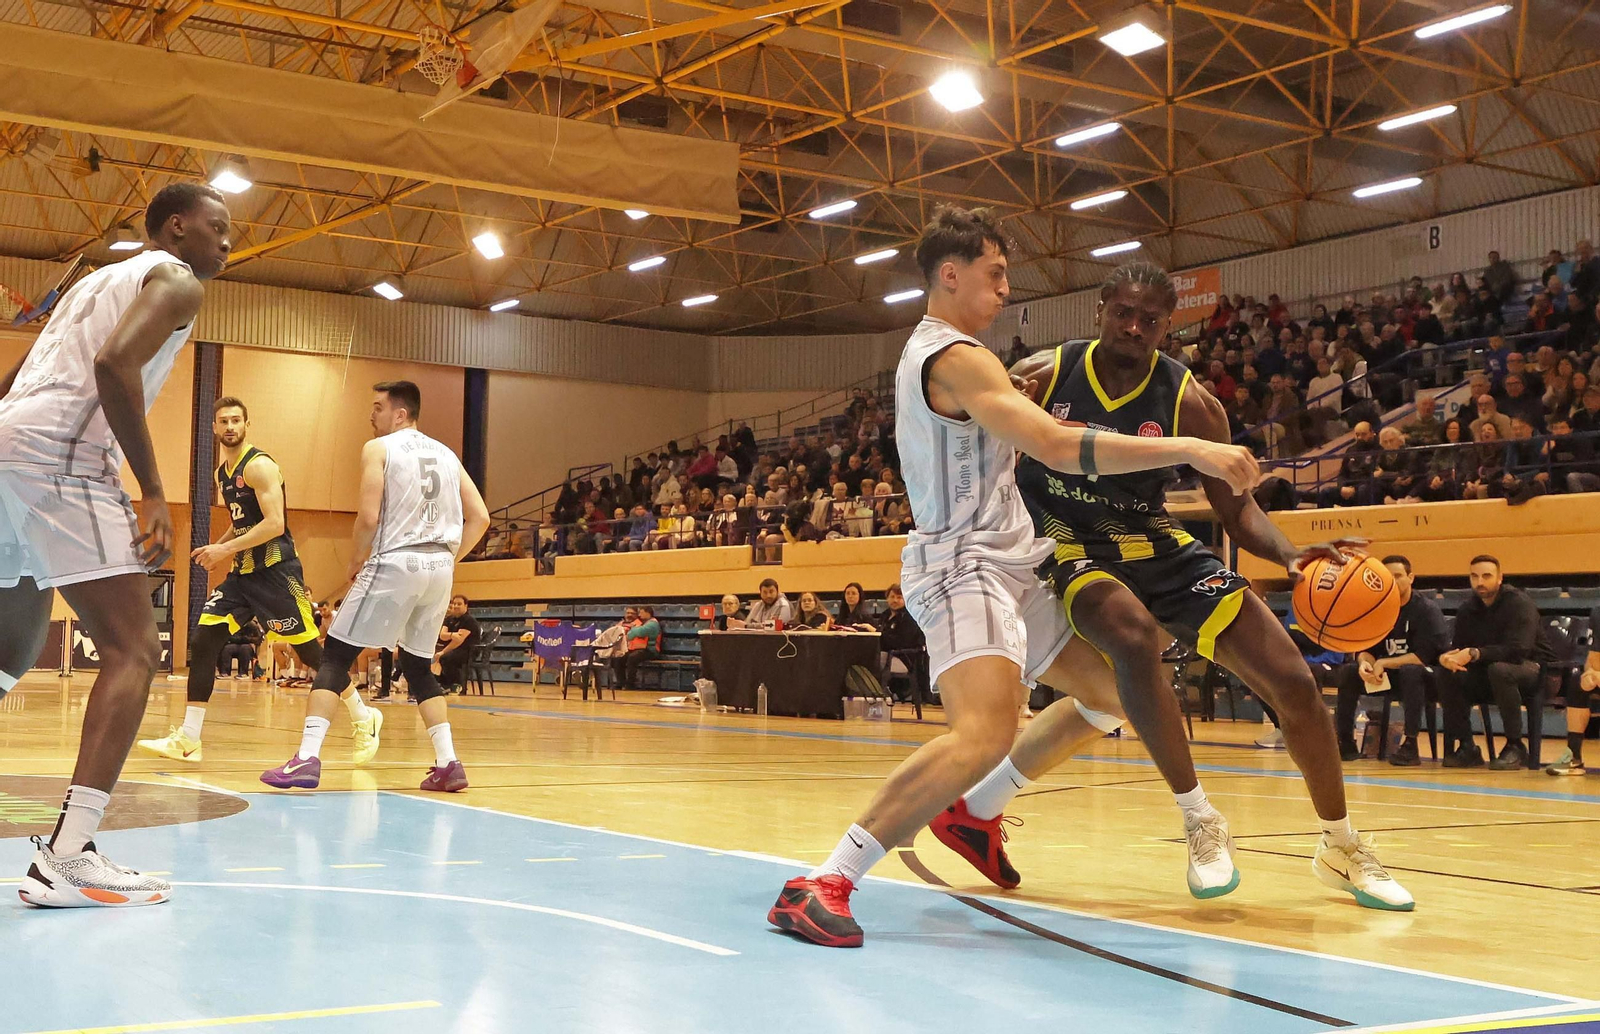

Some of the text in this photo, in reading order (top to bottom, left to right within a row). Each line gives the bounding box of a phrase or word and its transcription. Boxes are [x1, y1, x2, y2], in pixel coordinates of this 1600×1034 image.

[1430, 226, 1440, 249] B
[1021, 307, 1029, 325] A
[418, 457, 441, 500] 5
[229, 502, 245, 521] 22
[421, 502, 438, 522] MG
[1311, 519, 1363, 531] PRENSA
[1414, 515, 1430, 526] TV
[266, 617, 299, 632] UDEA
[537, 635, 563, 647] molten
